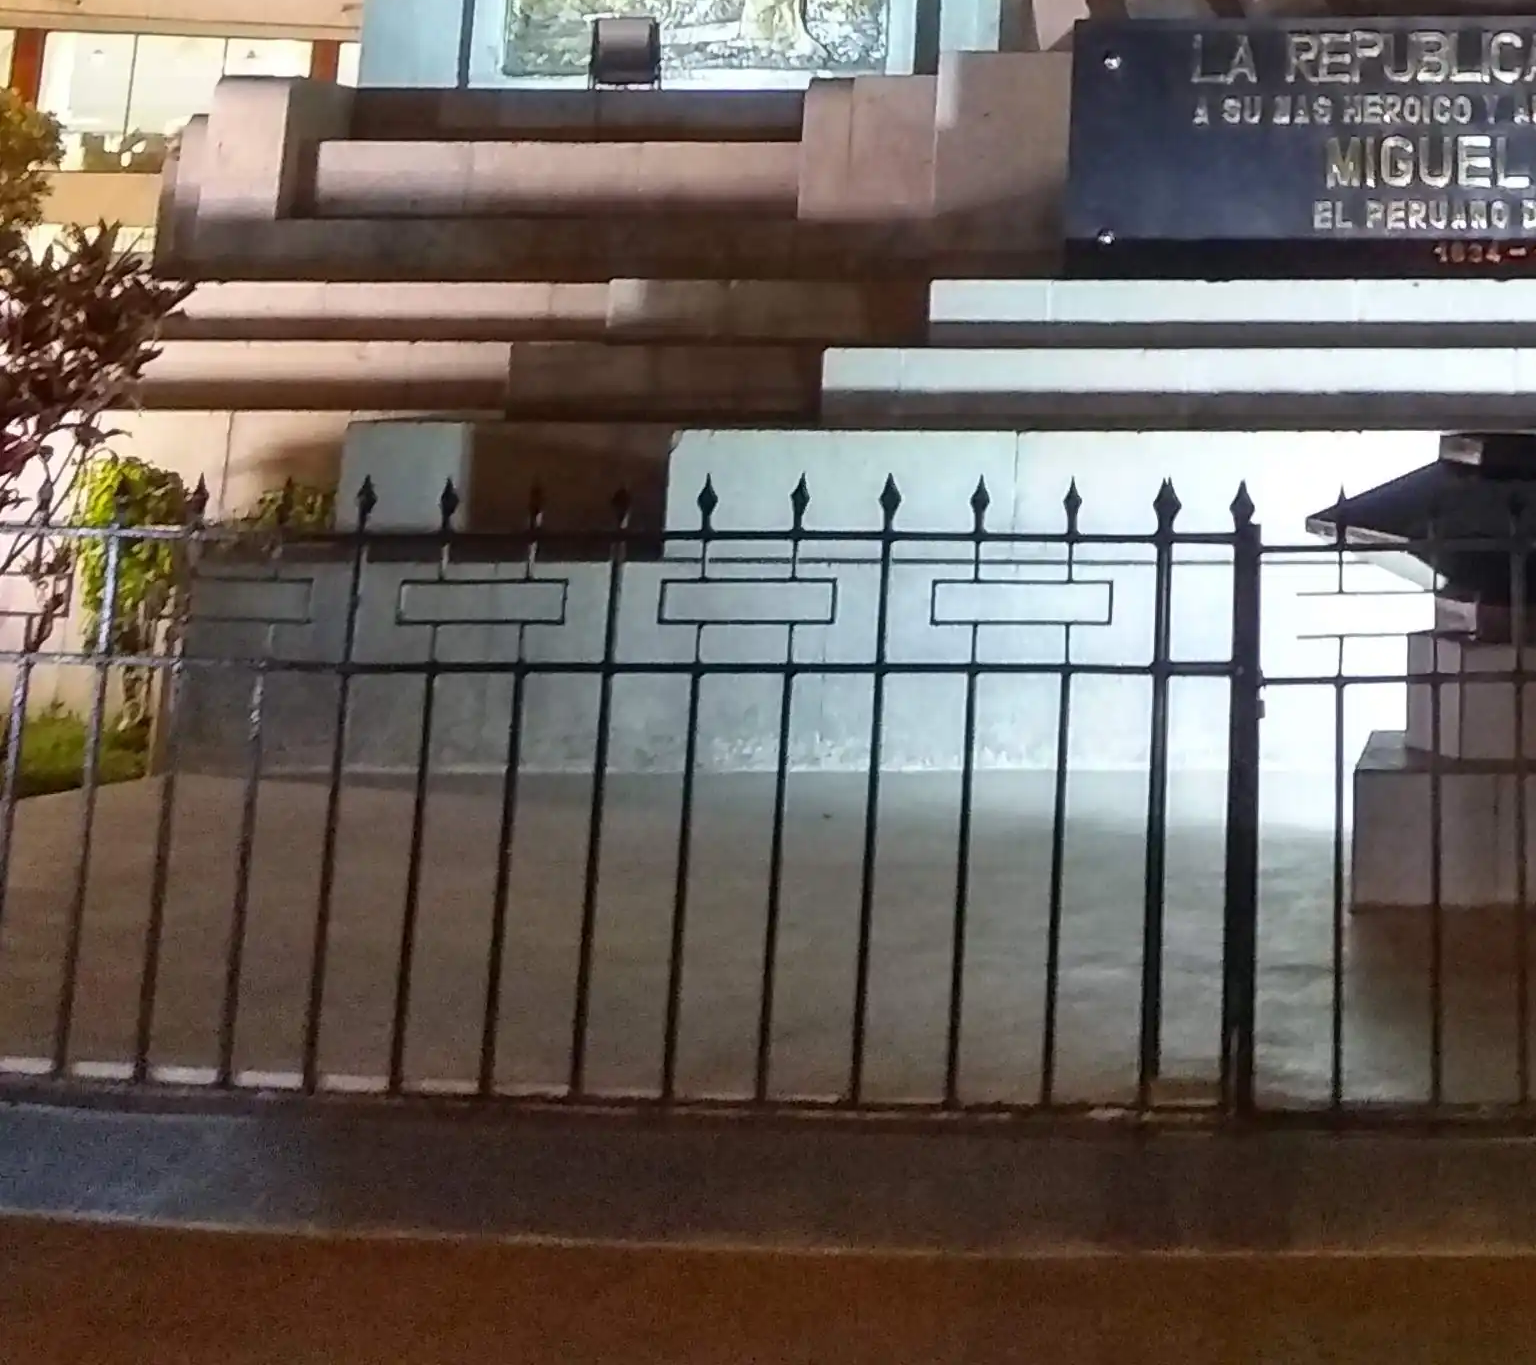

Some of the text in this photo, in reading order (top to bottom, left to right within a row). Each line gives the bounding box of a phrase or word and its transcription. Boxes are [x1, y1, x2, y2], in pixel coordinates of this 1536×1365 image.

[1191, 32, 1258, 84] LA
[1192, 94, 1210, 125] A
[1222, 95, 1262, 125] SU
[1273, 95, 1333, 125] MAS
[1343, 94, 1473, 125] HEROICO
[1483, 95, 1499, 125] Y
[1325, 134, 1530, 189] MIGUEL
[1313, 200, 1353, 230] EL
[1366, 200, 1510, 230] PERUANO
